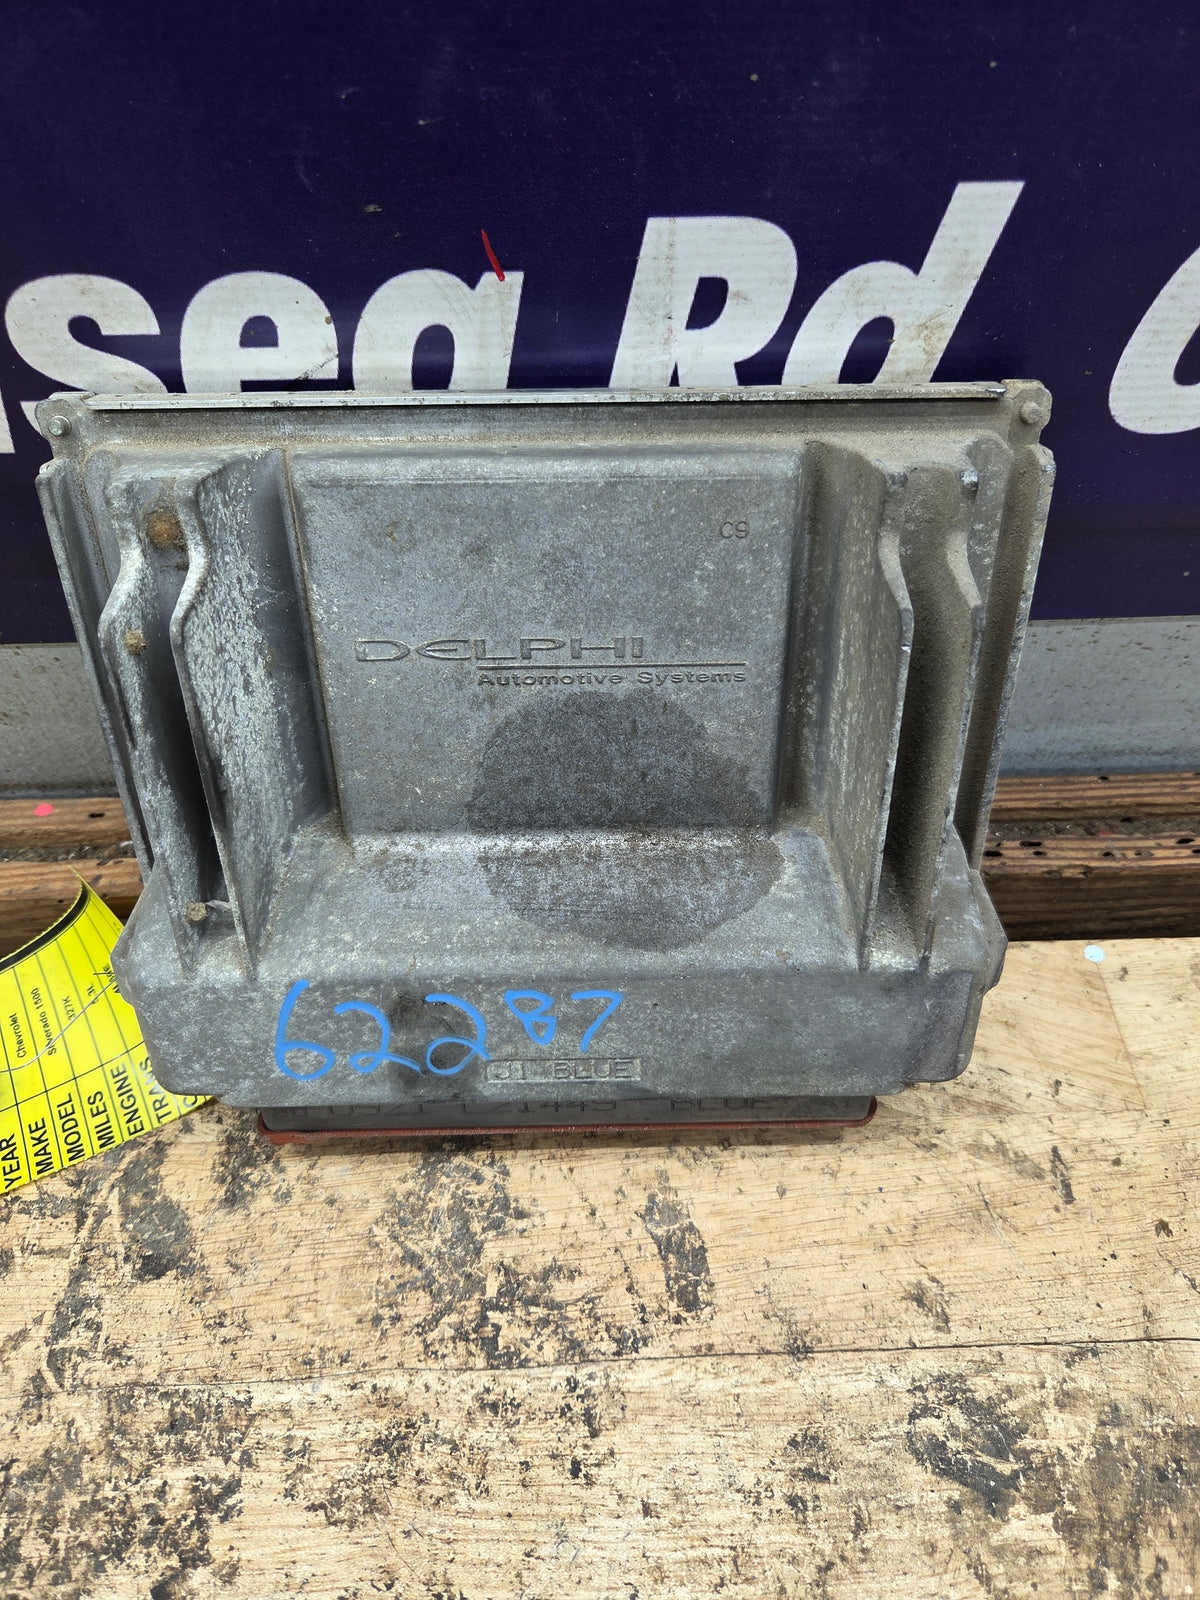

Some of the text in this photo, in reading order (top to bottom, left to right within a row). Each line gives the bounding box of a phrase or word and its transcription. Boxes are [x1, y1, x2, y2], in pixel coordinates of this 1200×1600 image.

[609, 180, 1025, 393] Rd
[719, 520, 750, 539] C9
[354, 636, 645, 662] DELPHI
[477, 669, 747, 687] Automotive Systems
[30, 986, 44, 1012] 1500
[9, 1013, 27, 1059] Chevrolet
[553, 1059, 633, 1079] BLUE
[87, 1090, 116, 1150] MILES
[110, 1061, 145, 1138] ENGINE
[29, 1116, 53, 1176] MAKE
[56, 1092, 86, 1162] MODEL
[1, 1132, 22, 1189] YEAR
